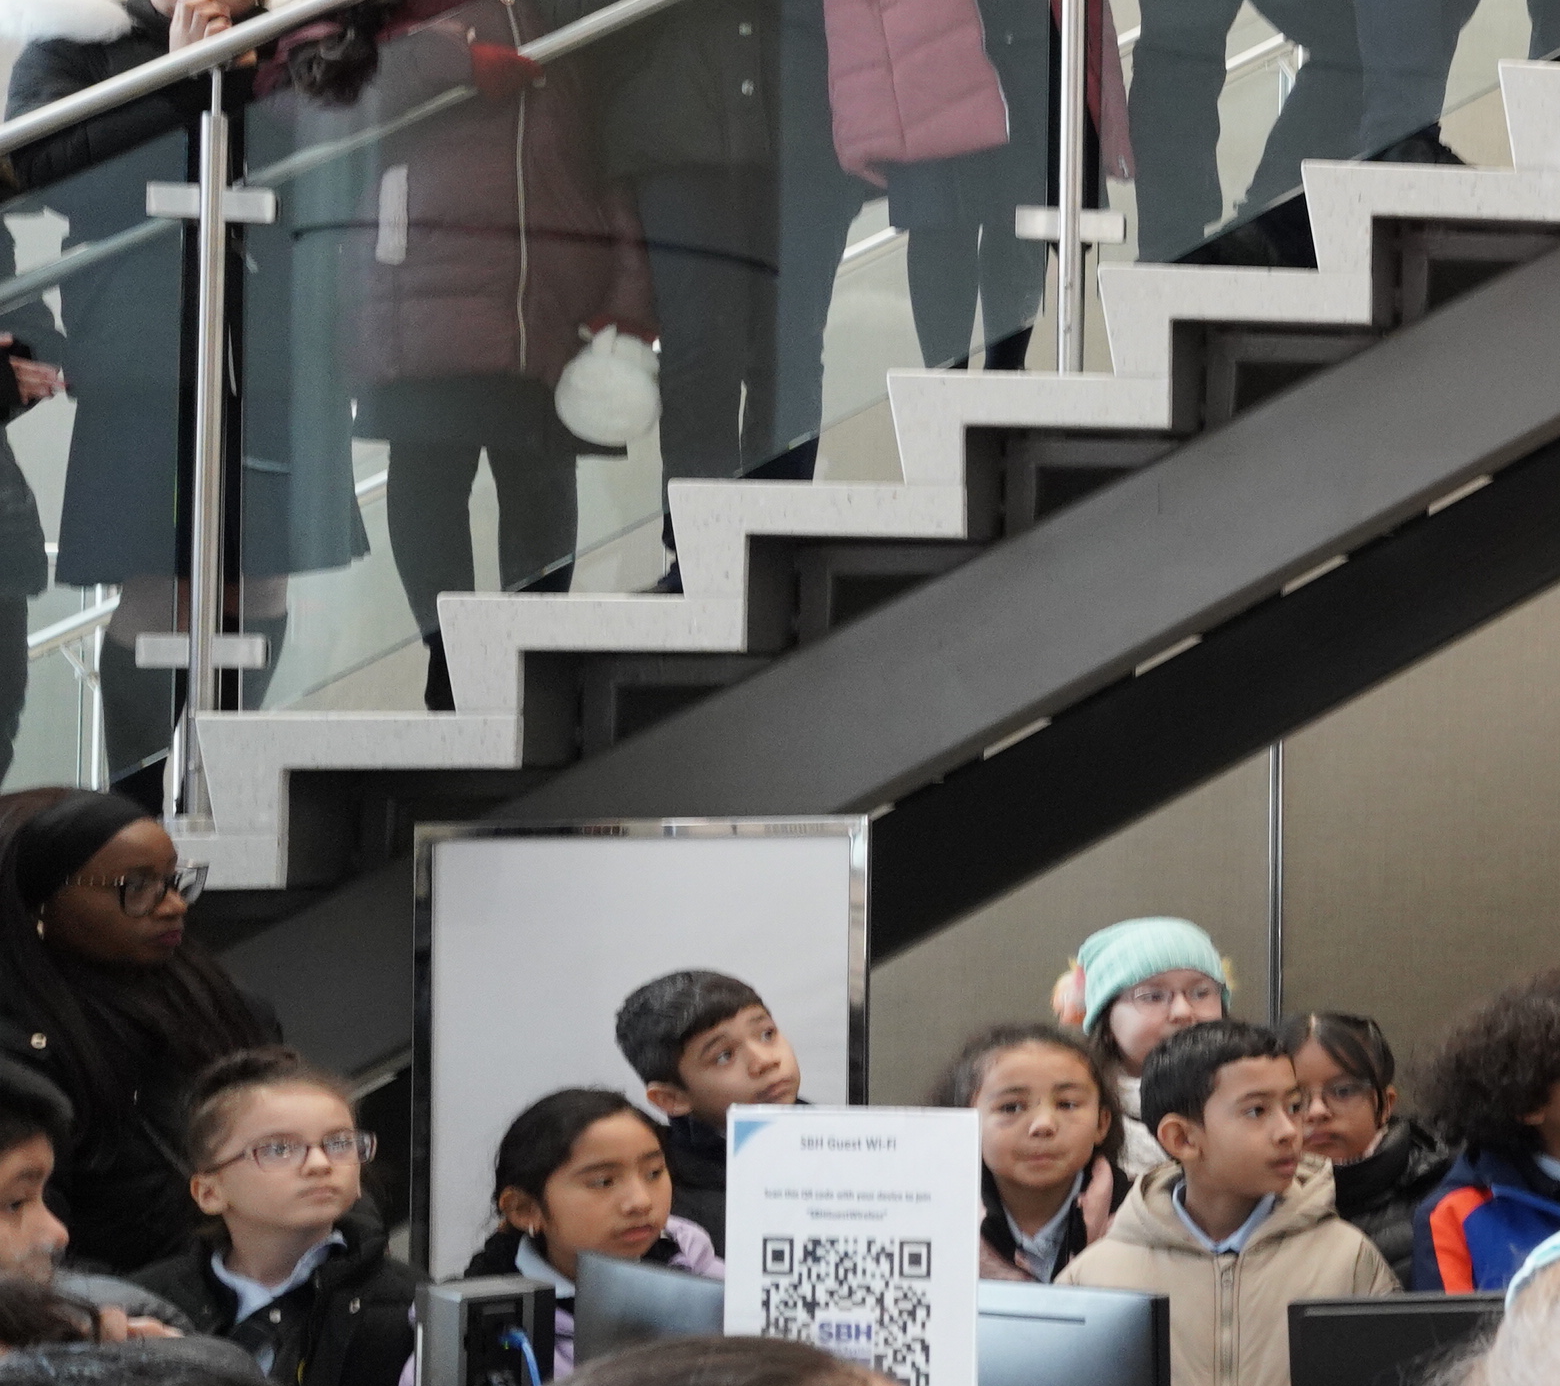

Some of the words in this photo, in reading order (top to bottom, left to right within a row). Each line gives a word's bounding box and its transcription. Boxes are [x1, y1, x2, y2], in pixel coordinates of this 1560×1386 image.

[801, 1136, 824, 1151] SBH
[827, 1136, 862, 1151] Guest
[818, 1321, 872, 1342] SBH
